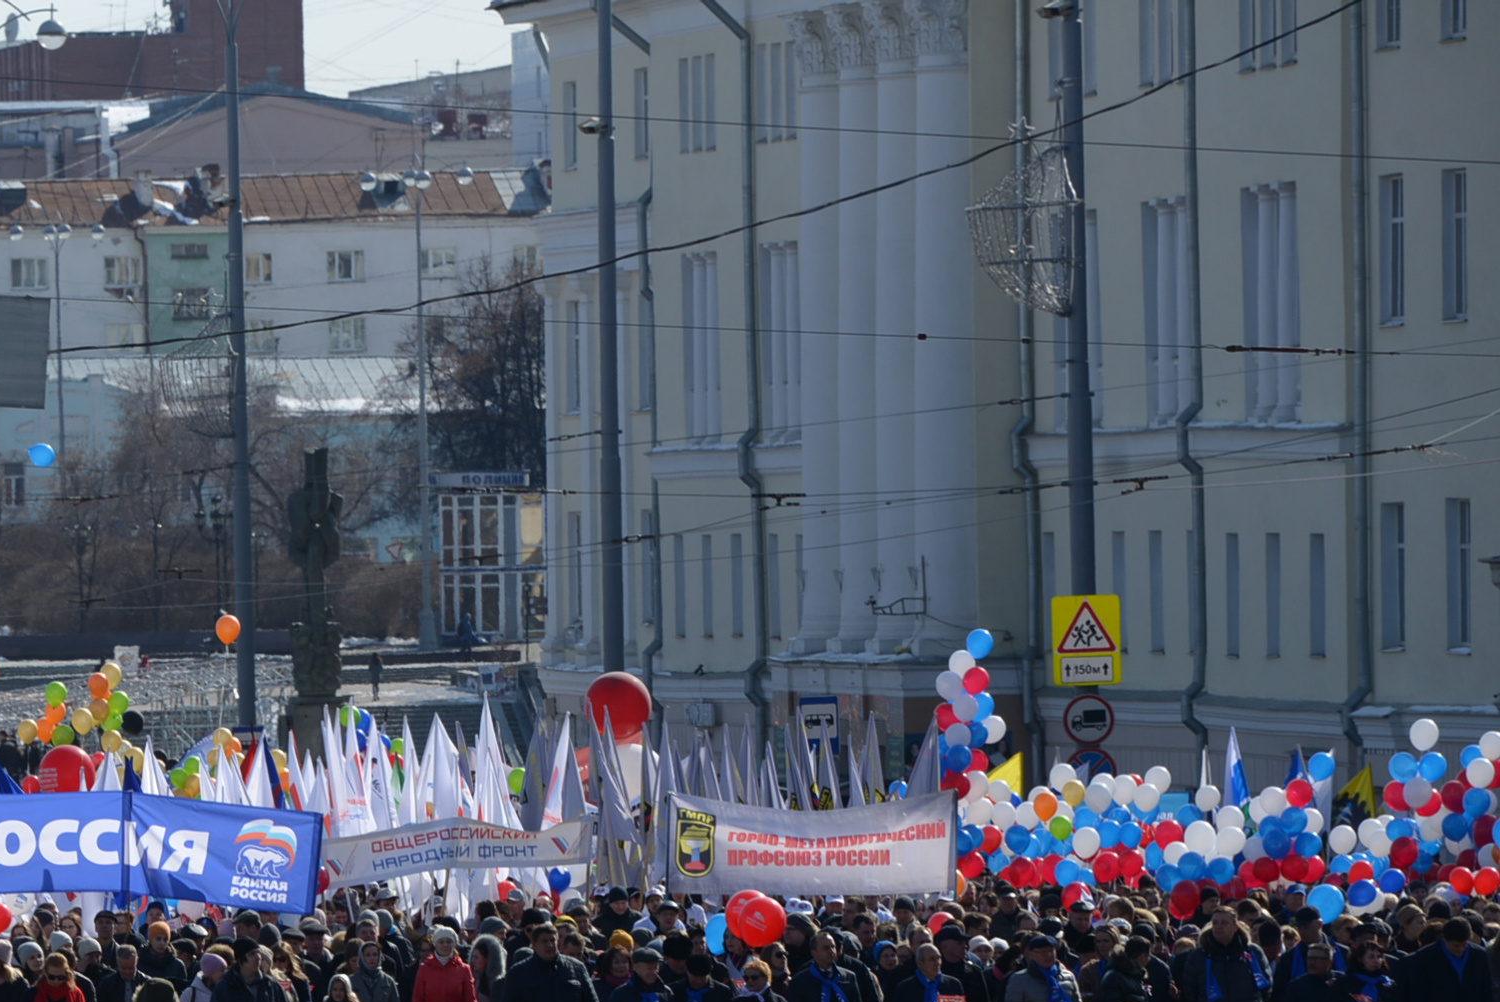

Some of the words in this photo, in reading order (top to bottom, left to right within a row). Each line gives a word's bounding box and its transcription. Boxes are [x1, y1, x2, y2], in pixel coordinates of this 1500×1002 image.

[372, 844, 470, 871] НАРОДНЫЙ
[478, 844, 538, 859] ФРОНТ
[726, 849, 822, 867] ПРОФСОЮЗ
[826, 849, 891, 866] РОССИИ
[231, 875, 289, 891] ЕДИНАЯ
[230, 886, 288, 903] РОССИЯ
